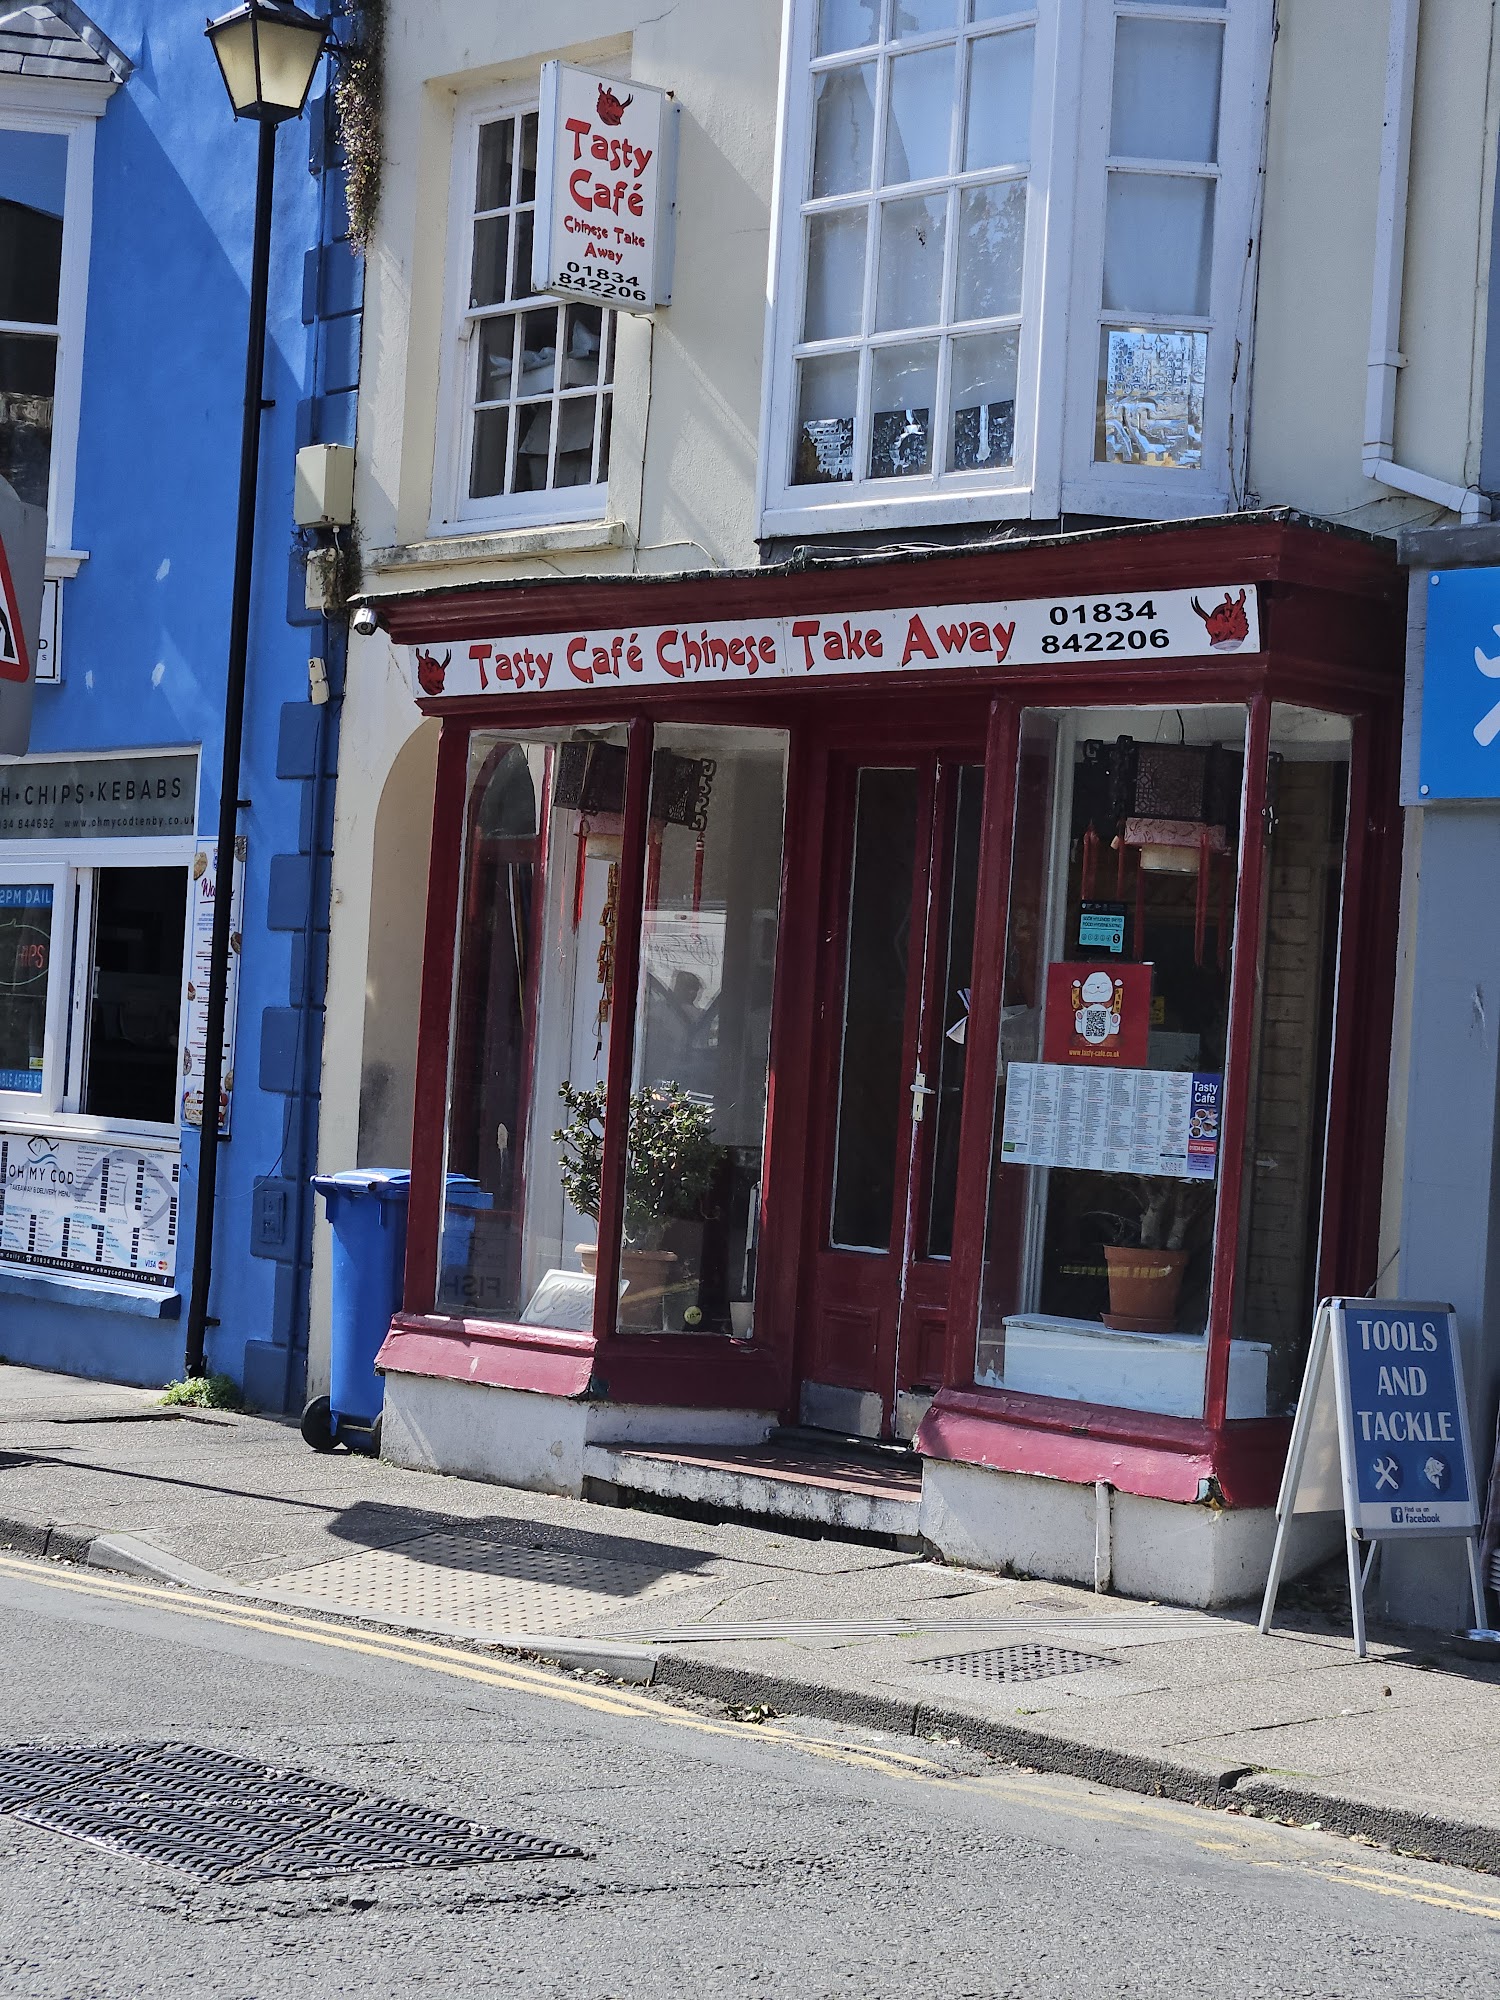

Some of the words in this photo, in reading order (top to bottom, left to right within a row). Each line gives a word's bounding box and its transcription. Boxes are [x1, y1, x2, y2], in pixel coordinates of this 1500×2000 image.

[565, 118, 652, 178] Tasty
[569, 168, 644, 217] Café
[564, 215, 608, 240] Chinese
[613, 227, 646, 248] Take
[584, 242, 623, 265] Away
[559, 272, 647, 301] 842206
[567, 261, 640, 287] 01834
[1050, 600, 1157, 625] 01834
[469, 644, 553, 690] Tasty
[566, 633, 643, 684] Café
[656, 628, 776, 678] Chinese
[792, 620, 883, 671] Take
[901, 613, 1016, 667] Away
[1041, 628, 1170, 654] 842206
[18, 818, 55, 829] 844692
[25, 889, 51, 904] DAIL
[1193, 1081, 1218, 1095] Tasty
[1194, 1092, 1216, 1104] Cafe
[8, 1164, 24, 1178] OH
[29, 1166, 46, 1181] MY
[50, 1169, 74, 1184] COD
[1357, 1321, 1438, 1352] TOOLS
[1378, 1366, 1427, 1396] AND
[1357, 1411, 1455, 1442] TACKLE
[1405, 1513, 1441, 1523] facebook
